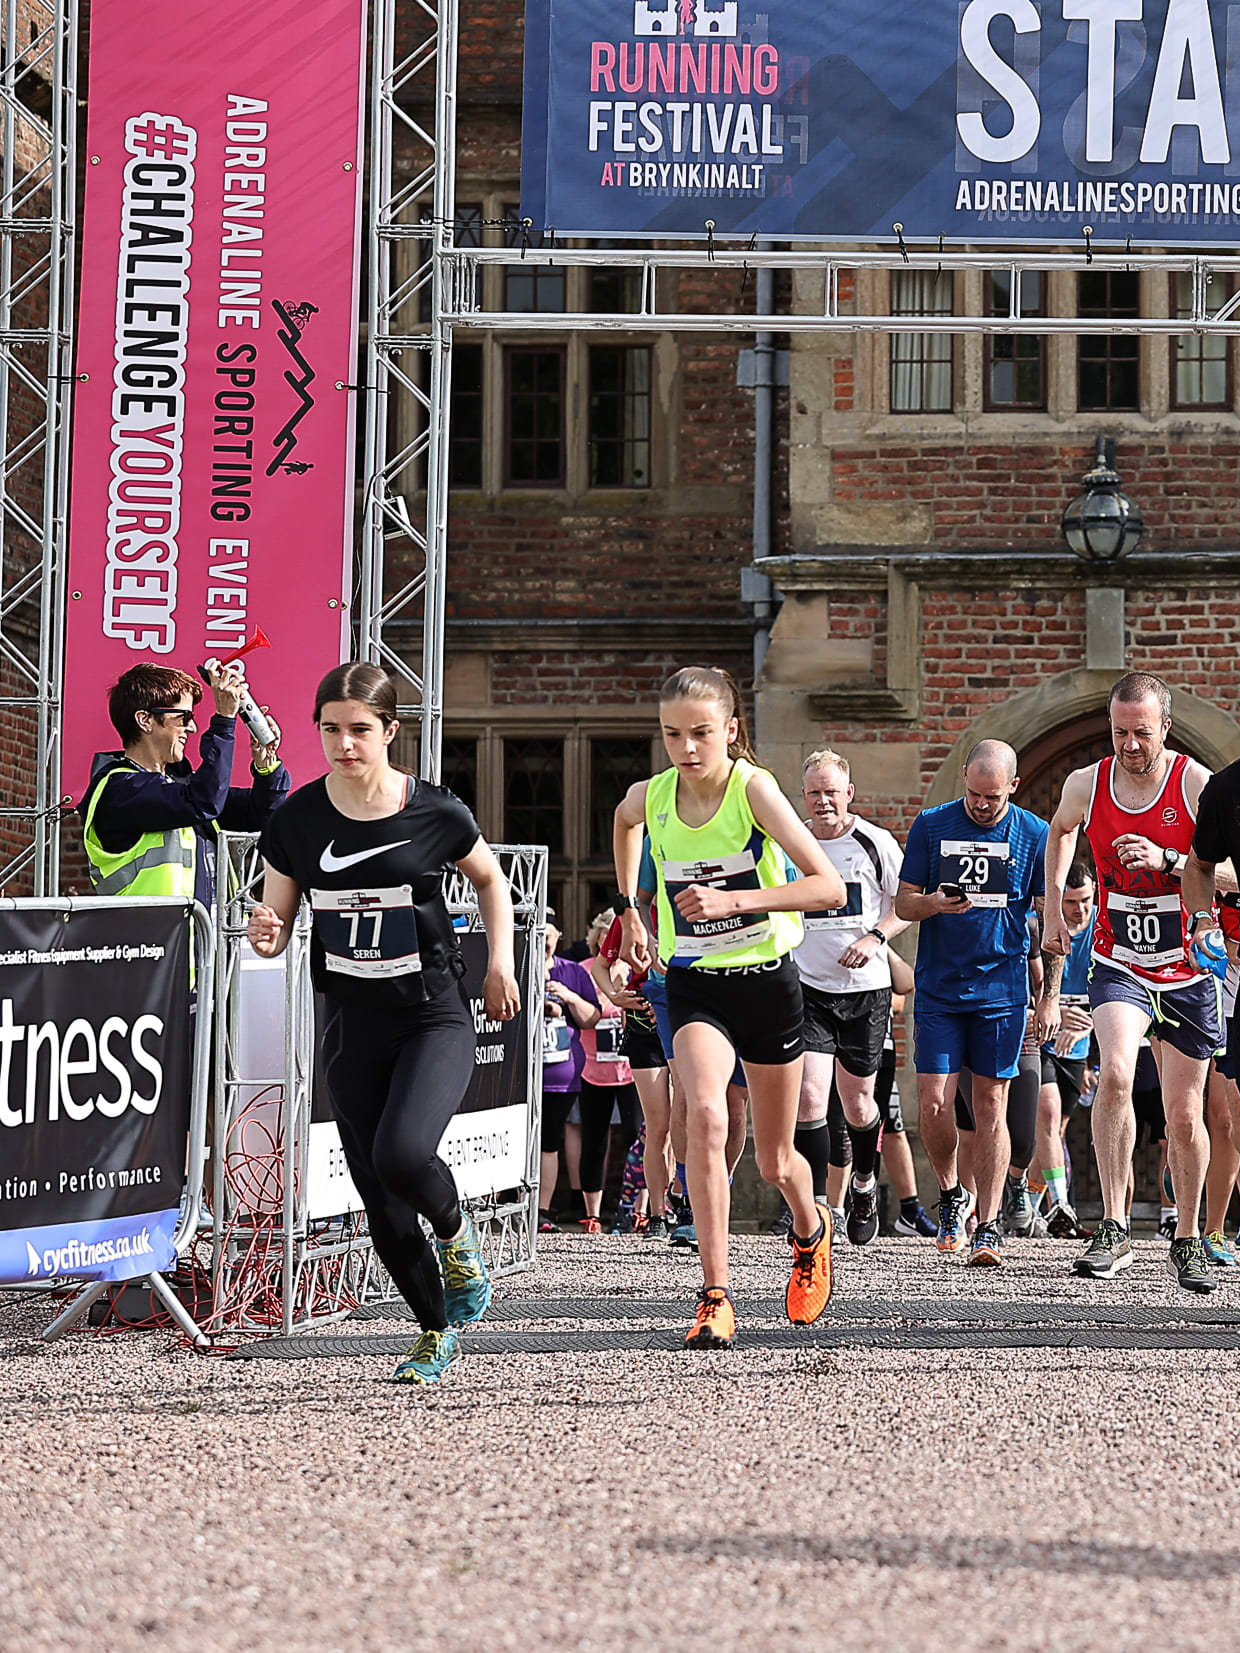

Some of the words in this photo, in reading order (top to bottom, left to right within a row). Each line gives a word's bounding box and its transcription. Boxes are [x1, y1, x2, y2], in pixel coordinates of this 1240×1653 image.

[590, 41, 780, 95] RUNNING
[588, 100, 783, 155] FESTIVAL
[601, 162, 626, 187] AT
[629, 163, 764, 189] BRYNKINALT
[217, 93, 269, 329] ADRENALINE
[104, 113, 196, 653] #CHALLENGEYOURSELF
[210, 342, 257, 523] SPORTING
[959, 856, 989, 885] 29
[965, 884, 981, 892] LUKE
[339, 911, 383, 947] 77
[692, 917, 743, 935] MACKENZIE
[1126, 914, 1160, 943] 80
[51, 948, 86, 965] Equipment
[86, 945, 116, 965] Supplier
[116, 945, 122, 959] &
[122, 945, 140, 962] Gym
[140, 944, 165, 961] Design
[353, 949, 381, 959] SEREN
[1133, 944, 1156, 953] WAYNE
[59, 1165, 161, 1193] Performance
[43, 1227, 154, 1277] cycfitness.co.uk
